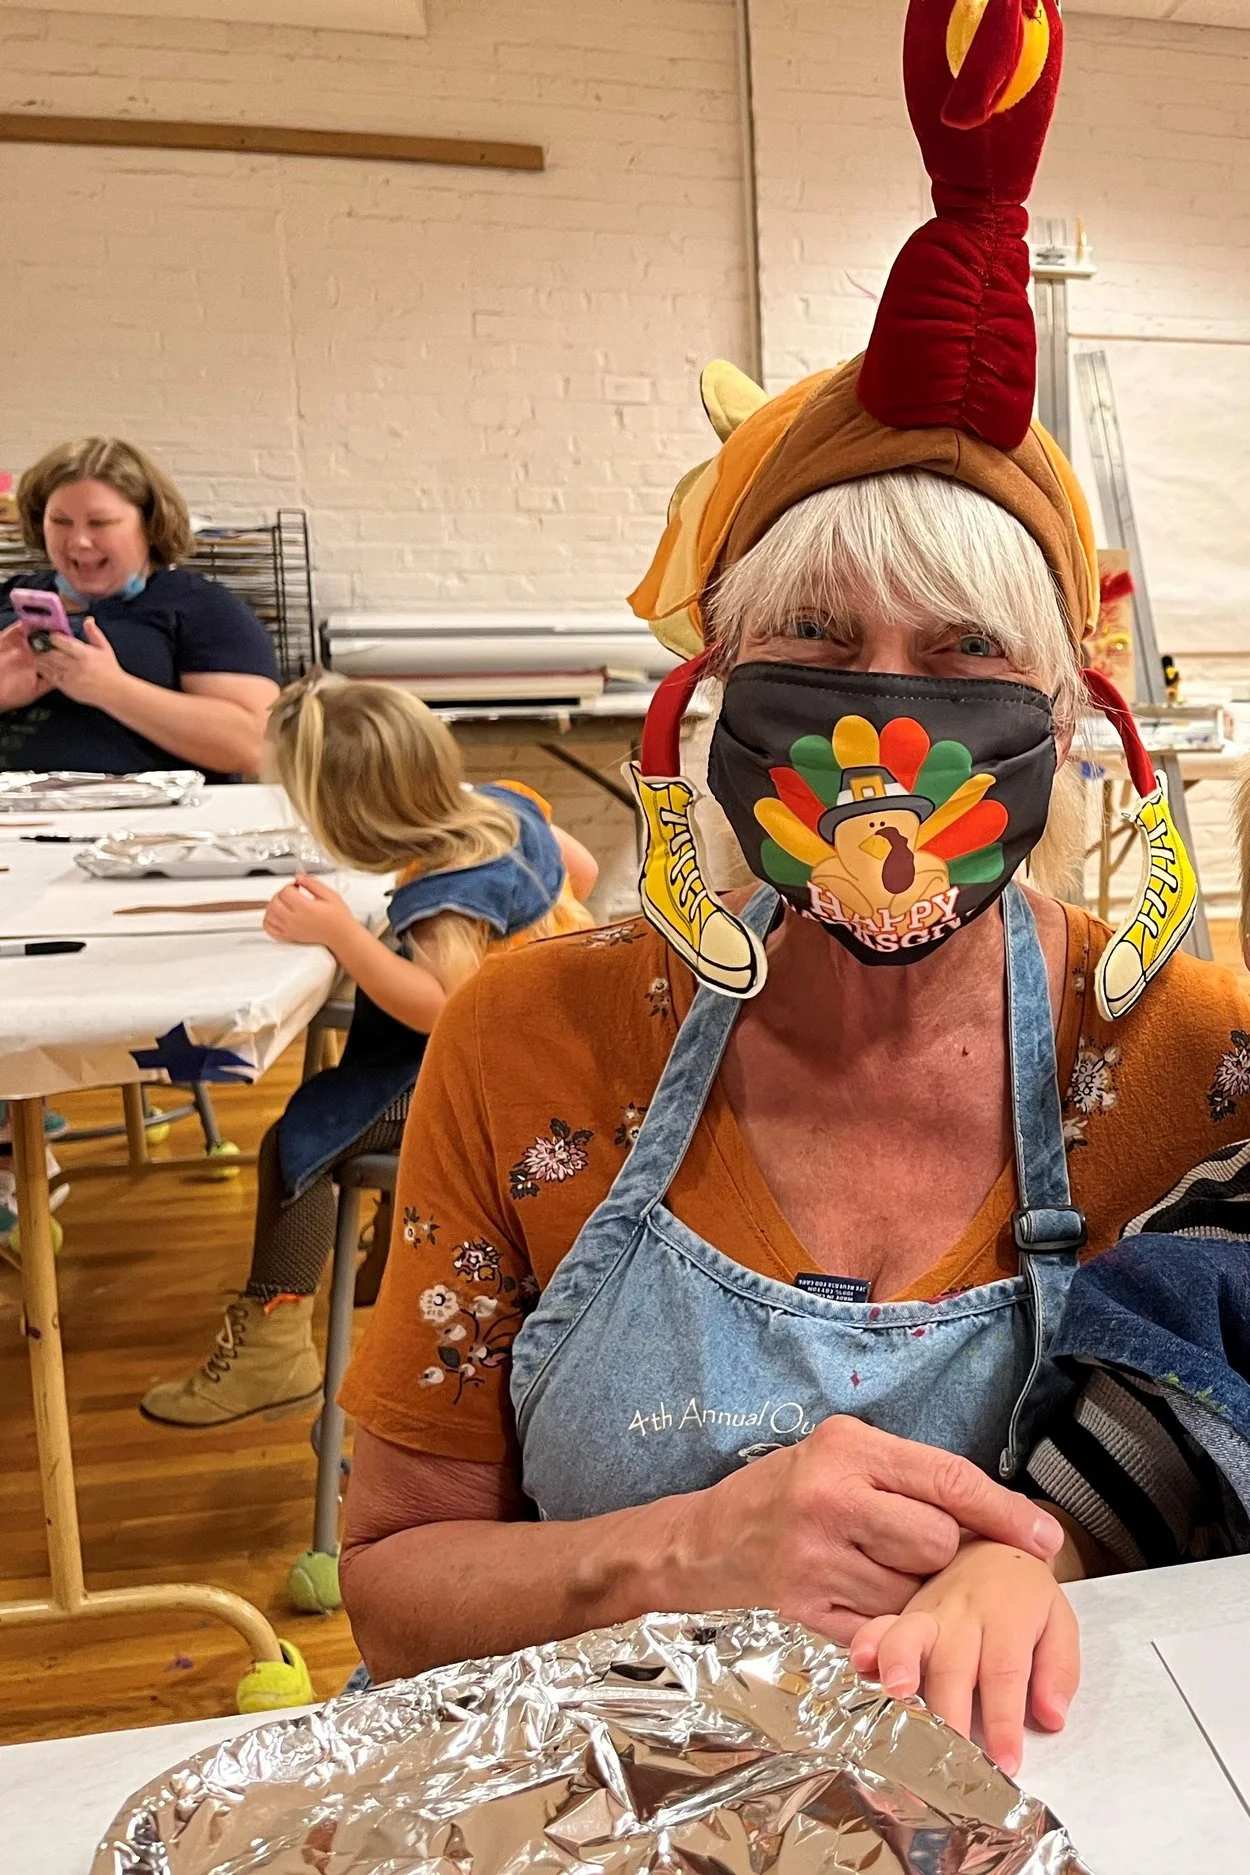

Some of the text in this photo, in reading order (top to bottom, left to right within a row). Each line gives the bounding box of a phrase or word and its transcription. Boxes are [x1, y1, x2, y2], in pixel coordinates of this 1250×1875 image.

[628, 1397, 815, 1437] 4th Annual Ou
